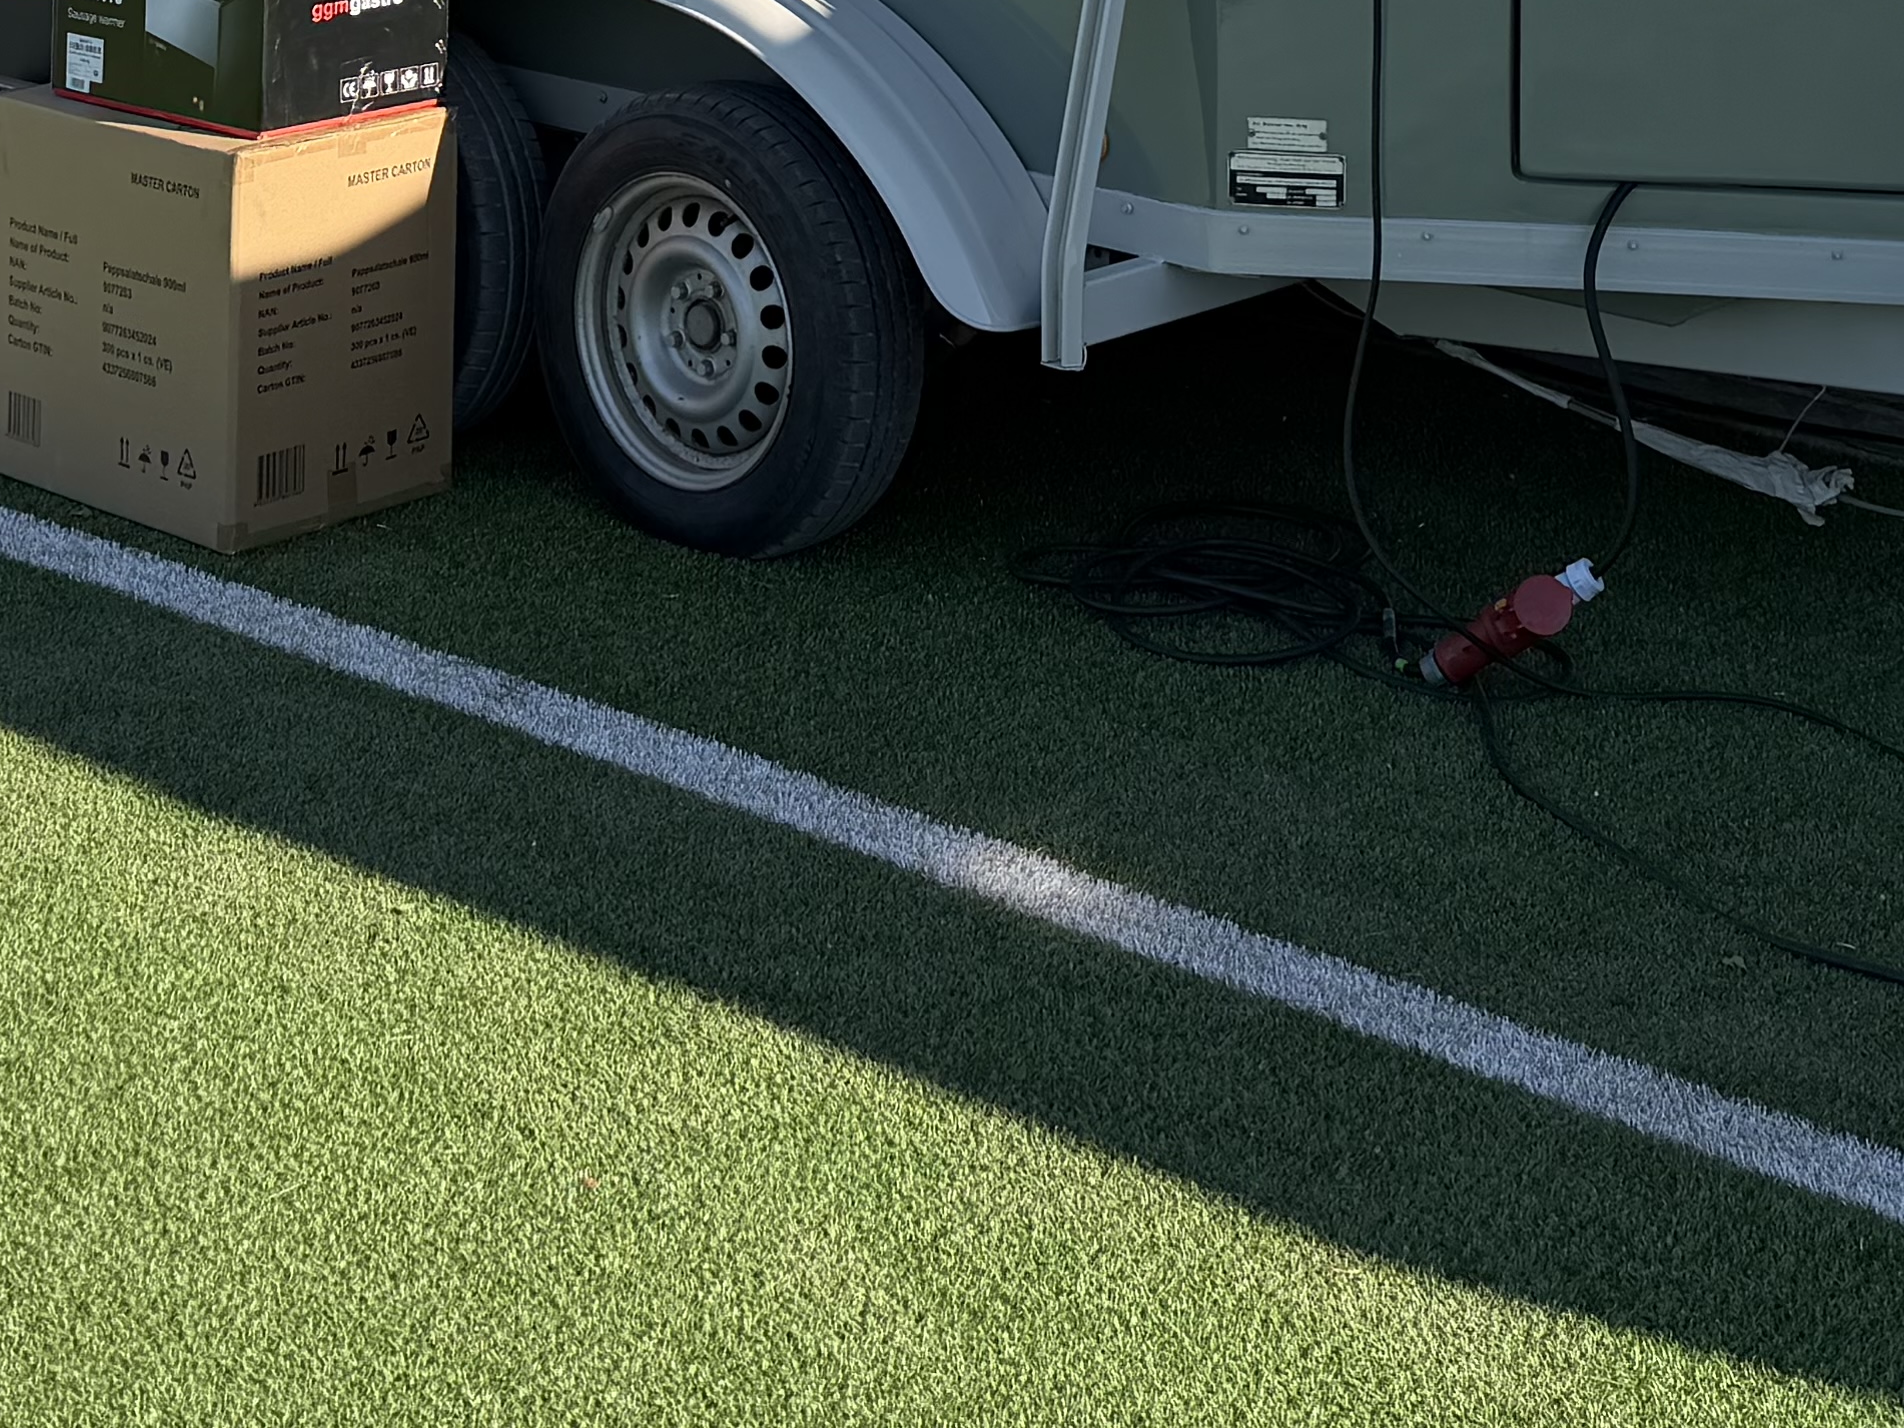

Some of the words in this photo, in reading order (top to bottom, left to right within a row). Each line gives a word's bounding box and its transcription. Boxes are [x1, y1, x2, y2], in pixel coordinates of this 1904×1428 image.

[347, 167, 389, 187] MASTER
[391, 158, 432, 178] CARTON
[130, 172, 164, 192] MASTER
[166, 181, 200, 199] CARTON
[9, 217, 37, 234] Product
[38, 225, 59, 240] Name
[10, 237, 29, 252] Name
[30, 243, 38, 253] of
[39, 285, 62, 301] Article
